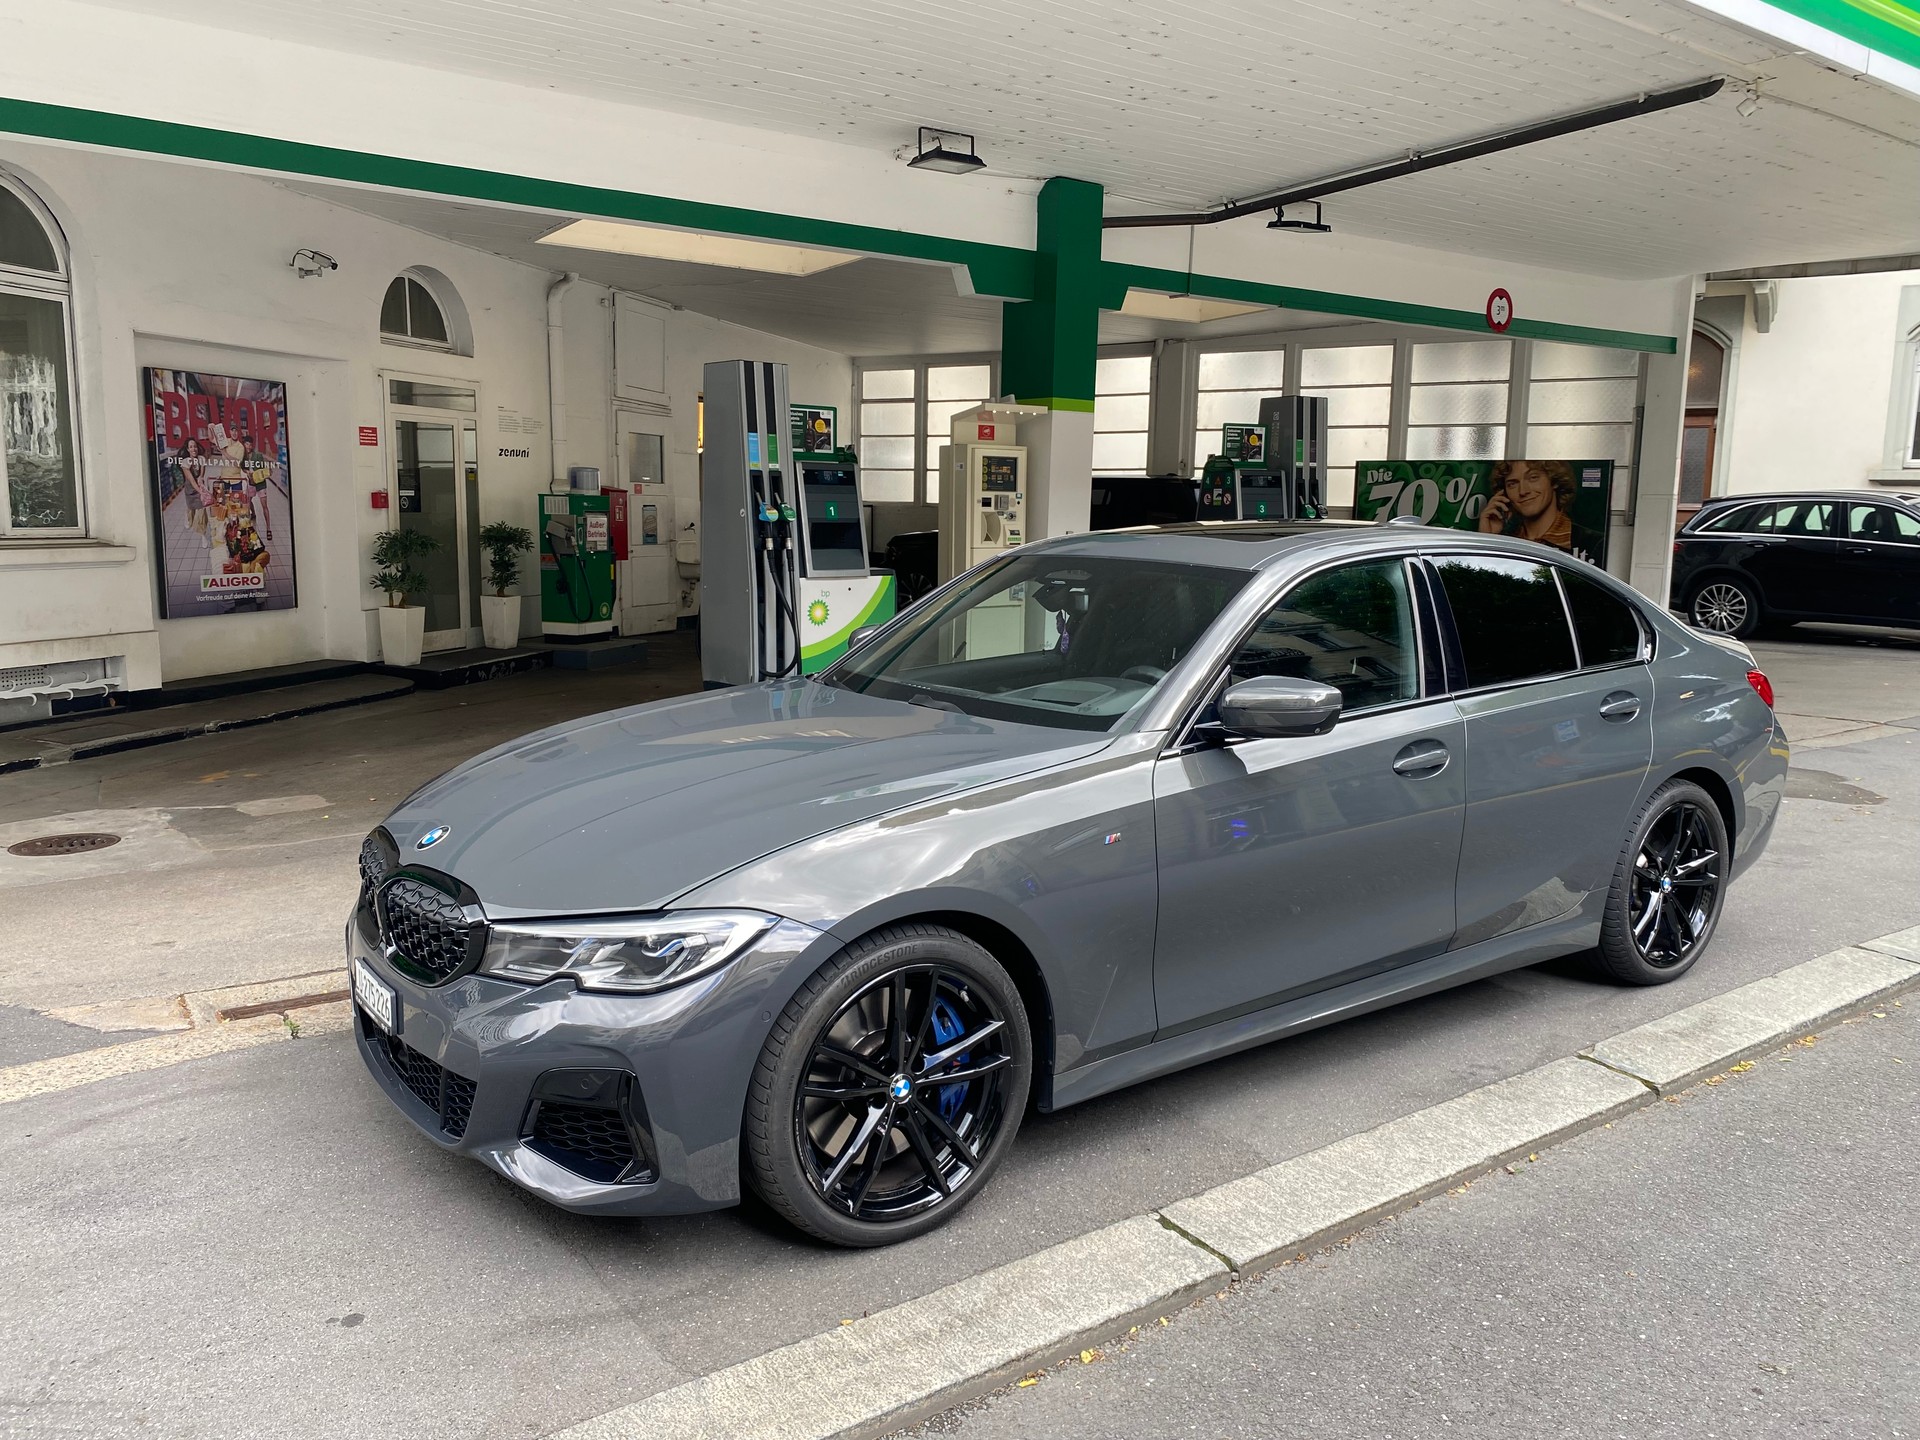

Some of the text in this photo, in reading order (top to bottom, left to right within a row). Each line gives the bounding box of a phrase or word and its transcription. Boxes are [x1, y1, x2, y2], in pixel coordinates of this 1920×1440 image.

[162, 391, 279, 460] BEVOR
[498, 447, 530, 458] zenuni
[167, 456, 281, 469] DIE GRILLPARTY BEGINNT
[1366, 468, 1393, 484] Die
[1368, 473, 1487, 526] 70%
[829, 506, 835, 516] 1
[1259, 504, 1265, 514] 3
[589, 521, 605, 529] Außer
[587, 530, 607, 538] Betrieb
[208, 576, 261, 588] ALIGRO
[820, 590, 831, 598] bp
[840, 943, 918, 988] BRIDGESTONE
